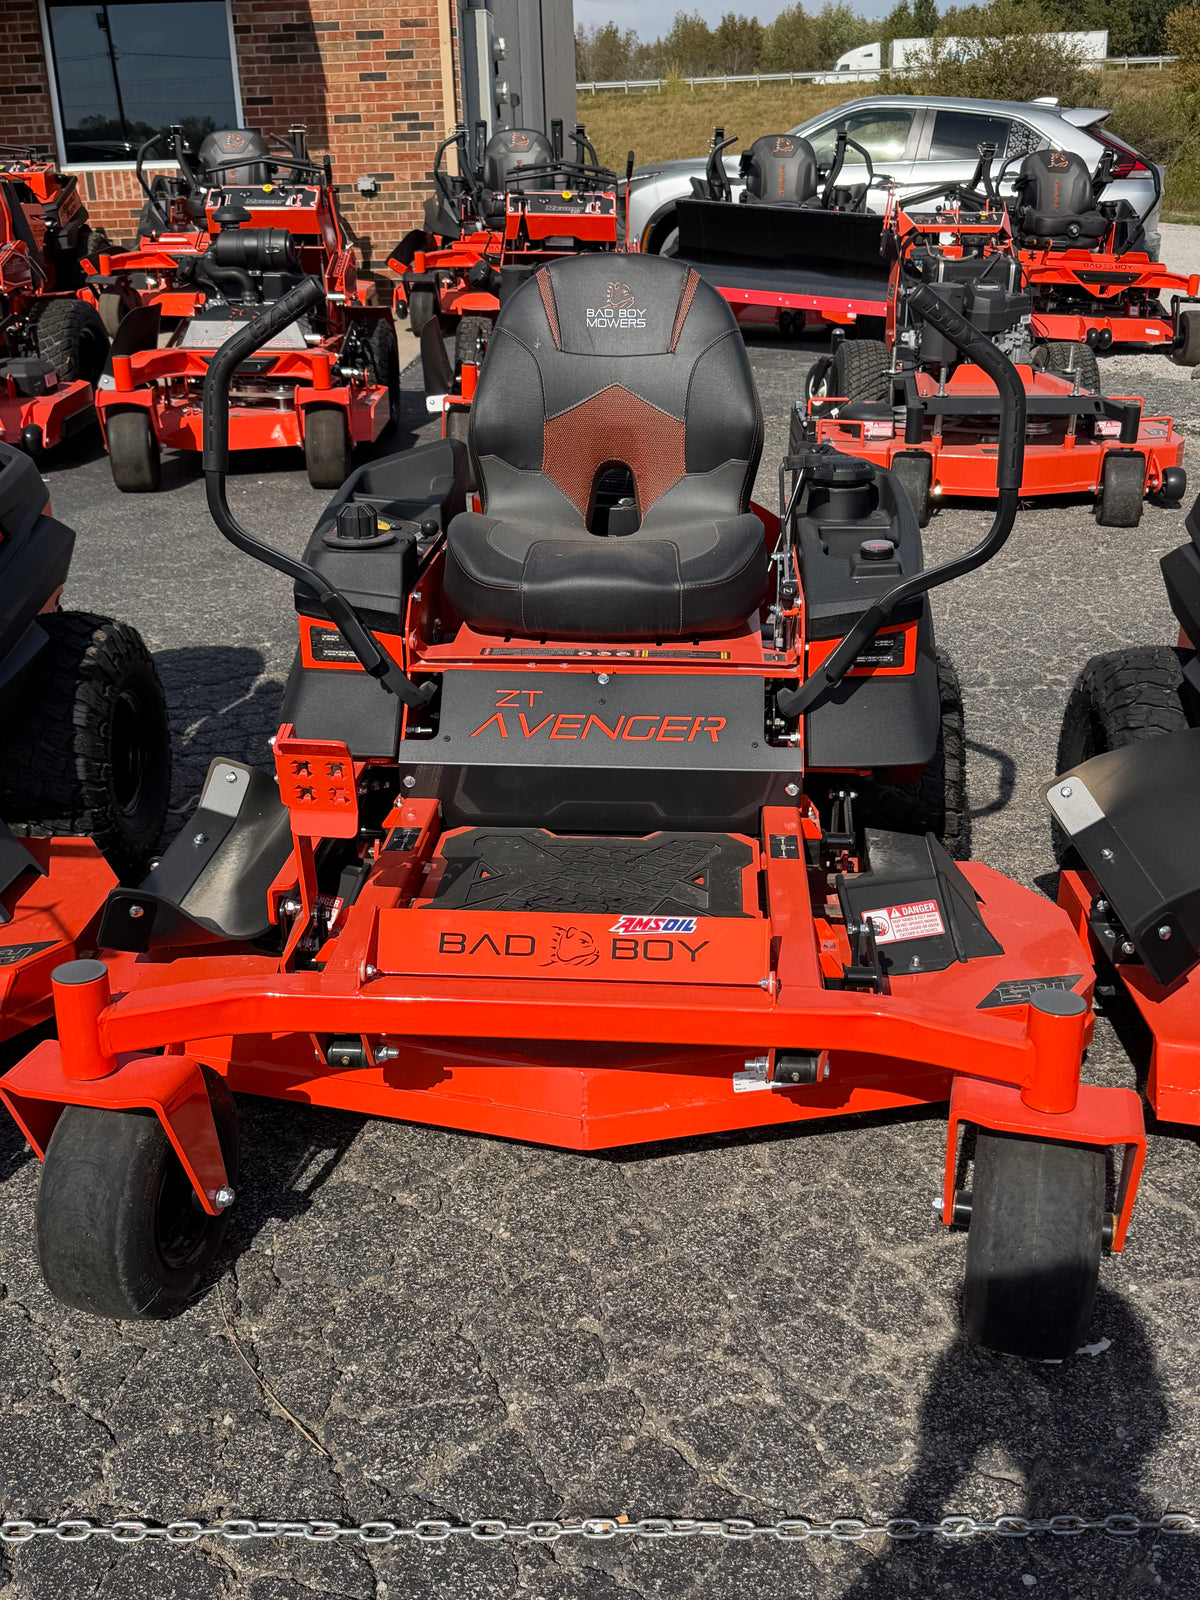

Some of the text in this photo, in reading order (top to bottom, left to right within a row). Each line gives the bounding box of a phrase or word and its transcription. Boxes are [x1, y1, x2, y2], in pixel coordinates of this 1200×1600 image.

[586, 308, 647, 318] BAD BOY
[586, 318, 647, 328] MOWERS
[495, 689, 543, 707] ZT
[469, 712, 727, 743] AVENGER
[314, 896, 340, 908] ANGER
[901, 902, 936, 916] DANGER
[612, 917, 695, 933] AMSOIL
[438, 932, 711, 962] BAD BOY
